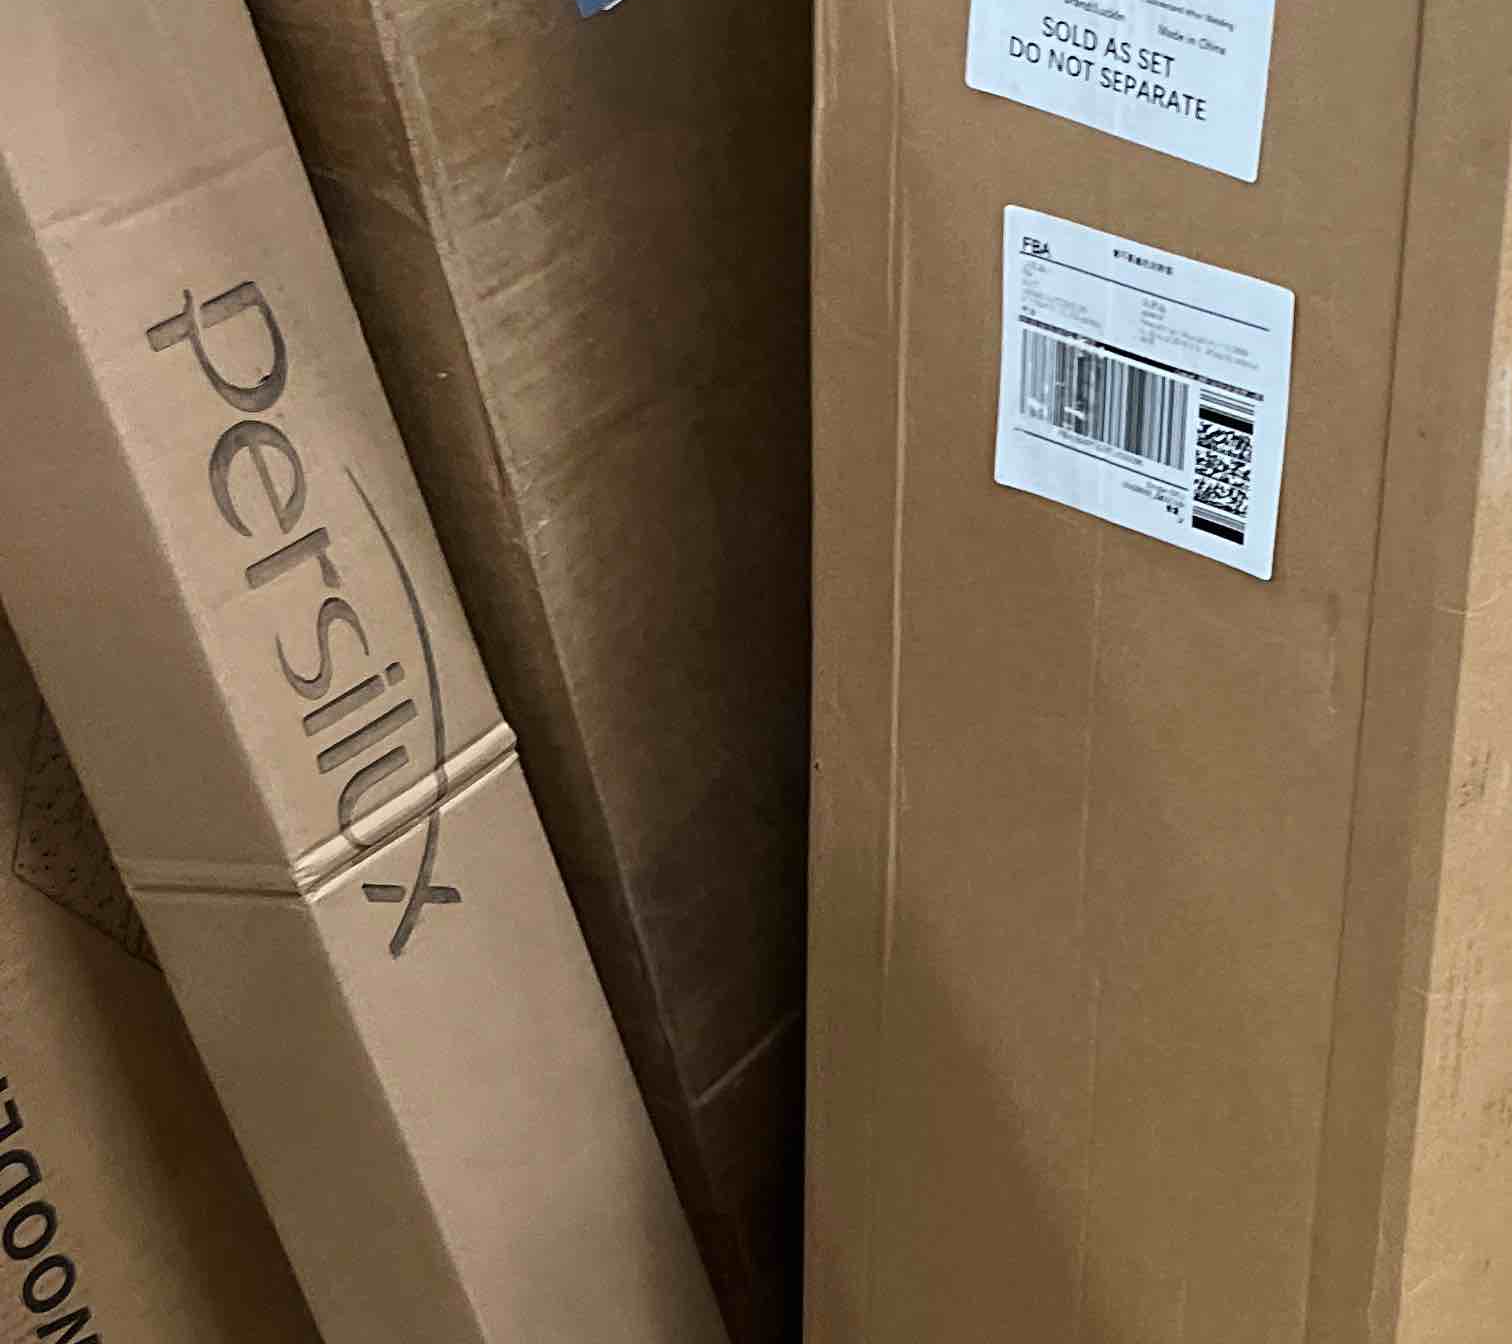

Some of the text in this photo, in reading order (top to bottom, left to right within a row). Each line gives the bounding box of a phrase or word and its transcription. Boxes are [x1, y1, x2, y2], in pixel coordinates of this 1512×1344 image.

[1008, 36, 1208, 122] DO NOT SEPARATE
[1041, 16, 1175, 78] SOLD AS SET
